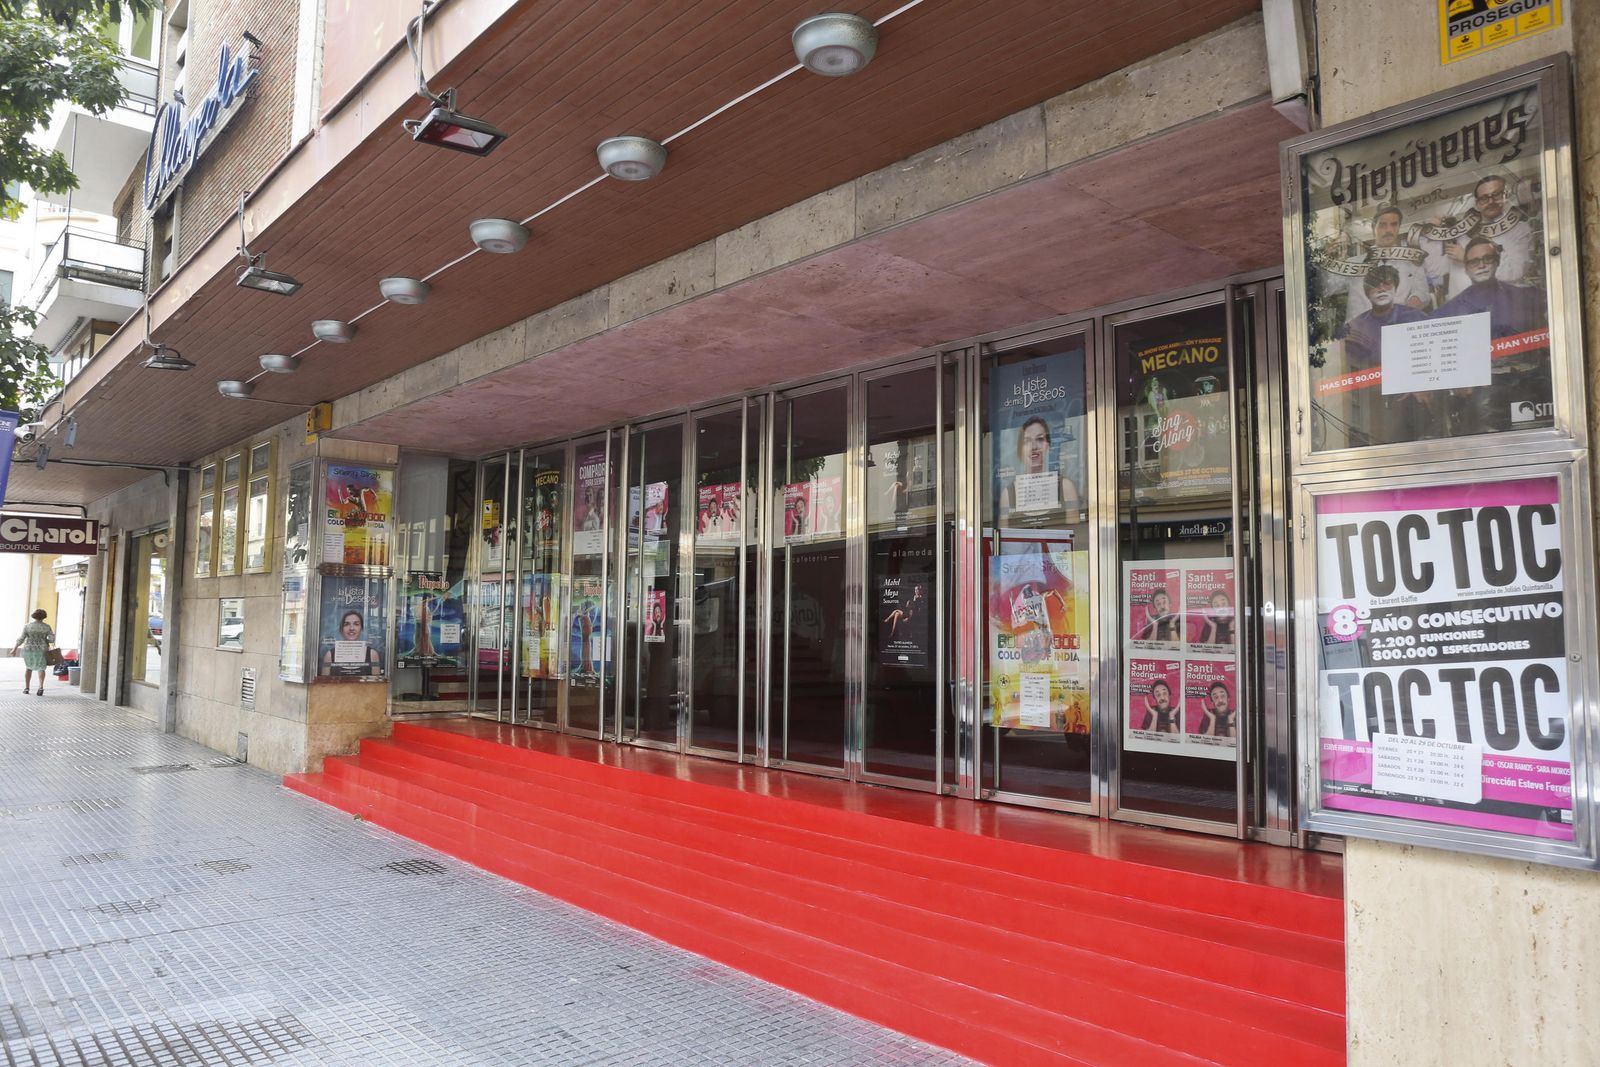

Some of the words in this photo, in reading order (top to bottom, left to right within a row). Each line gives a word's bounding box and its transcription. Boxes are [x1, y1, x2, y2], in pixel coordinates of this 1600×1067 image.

[1497, 340, 1520, 350] HAN
[1142, 346, 1218, 374] MECANO
[1022, 376, 1048, 394] Lista
[1341, 378, 1354, 386] DE
[1023, 386, 1065, 408] Deseos
[1153, 426, 1195, 452] Along
[536, 475, 558, 487] MECANO
[1326, 514, 1434, 600] TOC
[1438, 504, 1562, 590] TOC
[1132, 572, 1155, 581] Santi
[1188, 572, 1213, 582] Santi
[1522, 583, 1553, 591] Quintanilla
[1370, 613, 1414, 633] AÑO
[1417, 602, 1562, 629] CONSECUTIVO
[1372, 635, 1415, 649] 2.200
[1420, 630, 1484, 643] FUNCIONES
[1054, 652, 1079, 661] INDIA
[1372, 646, 1438, 661] 800.000
[1442, 640, 1530, 655] ESPECTADORES
[1131, 662, 1155, 672] Santi
[1187, 663, 1212, 673] Santi
[1327, 668, 1436, 740] TOC
[1439, 663, 1564, 751] TOC
[1437, 742, 1464, 751] OCTUBRE
[1515, 763, 1533, 772] RAMOS
[1537, 765, 1550, 773] SARA
[1481, 775, 1516, 787] Dirección
[1519, 779, 1544, 790] Esteve
